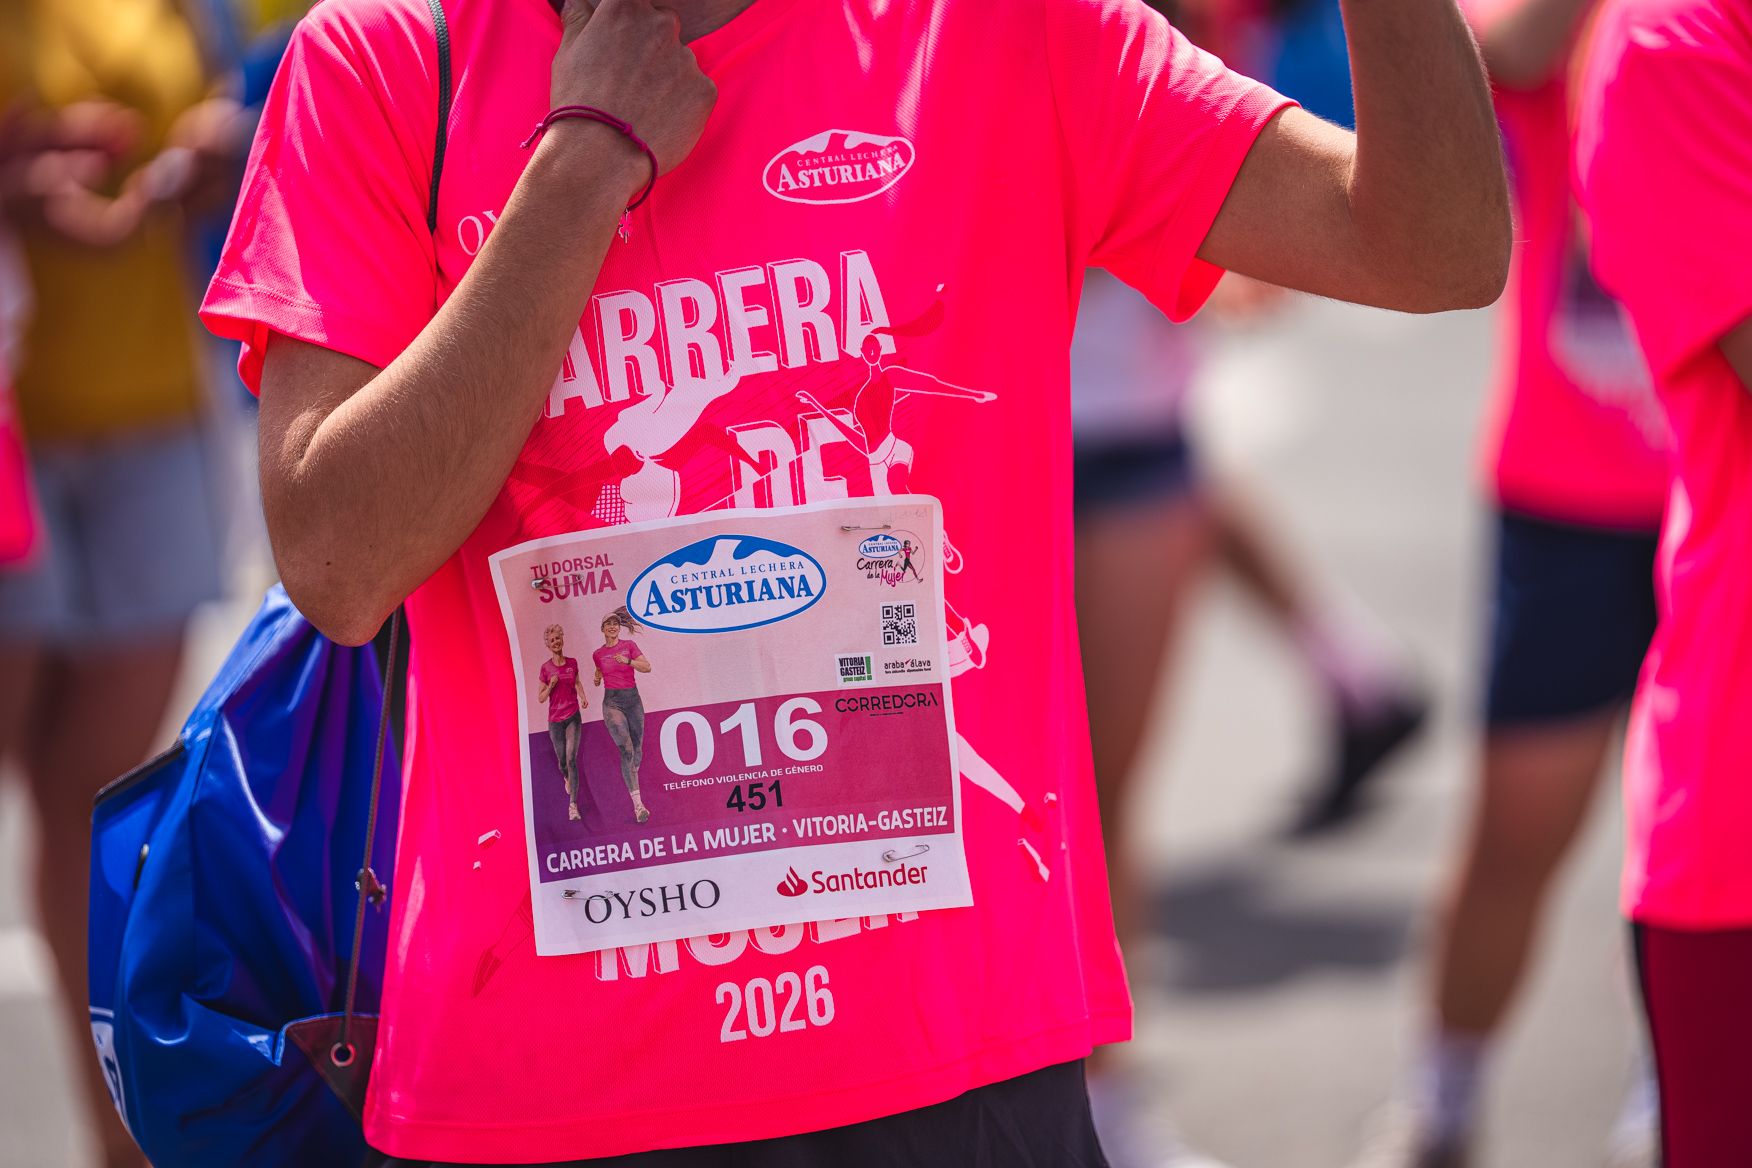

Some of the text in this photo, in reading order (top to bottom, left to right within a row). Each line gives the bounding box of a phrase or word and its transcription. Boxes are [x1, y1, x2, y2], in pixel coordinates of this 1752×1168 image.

[797, 144, 898, 167] CENTRAL LECHERA
[776, 152, 906, 192] ASTURIANA
[541, 249, 897, 419] ARRERA
[862, 544, 900, 553] ASTURIANA
[530, 553, 614, 579] TU DORSAL
[671, 561, 805, 584] CENTRAL LECHERA
[857, 558, 893, 570] Carrera
[867, 568, 905, 587] de la Mujer
[539, 568, 618, 603] SUMA
[643, 574, 815, 617] ASTURIANA
[839, 656, 865, 667] VITORIA
[840, 666, 866, 677] GASTEIZ
[884, 659, 931, 670] araba álava
[835, 692, 938, 713] CORREDORA
[659, 696, 828, 776] 016
[663, 764, 823, 791] TELÉFONO VIOLENCIA DE GÉNERO
[726, 780, 783, 812] 451
[546, 806, 948, 873] CARRERA DE LA MUJER VITORIA-GASTEIZ
[811, 863, 928, 894] Santander
[584, 879, 721, 924] OYSHO
[715, 964, 835, 1043] 2026
